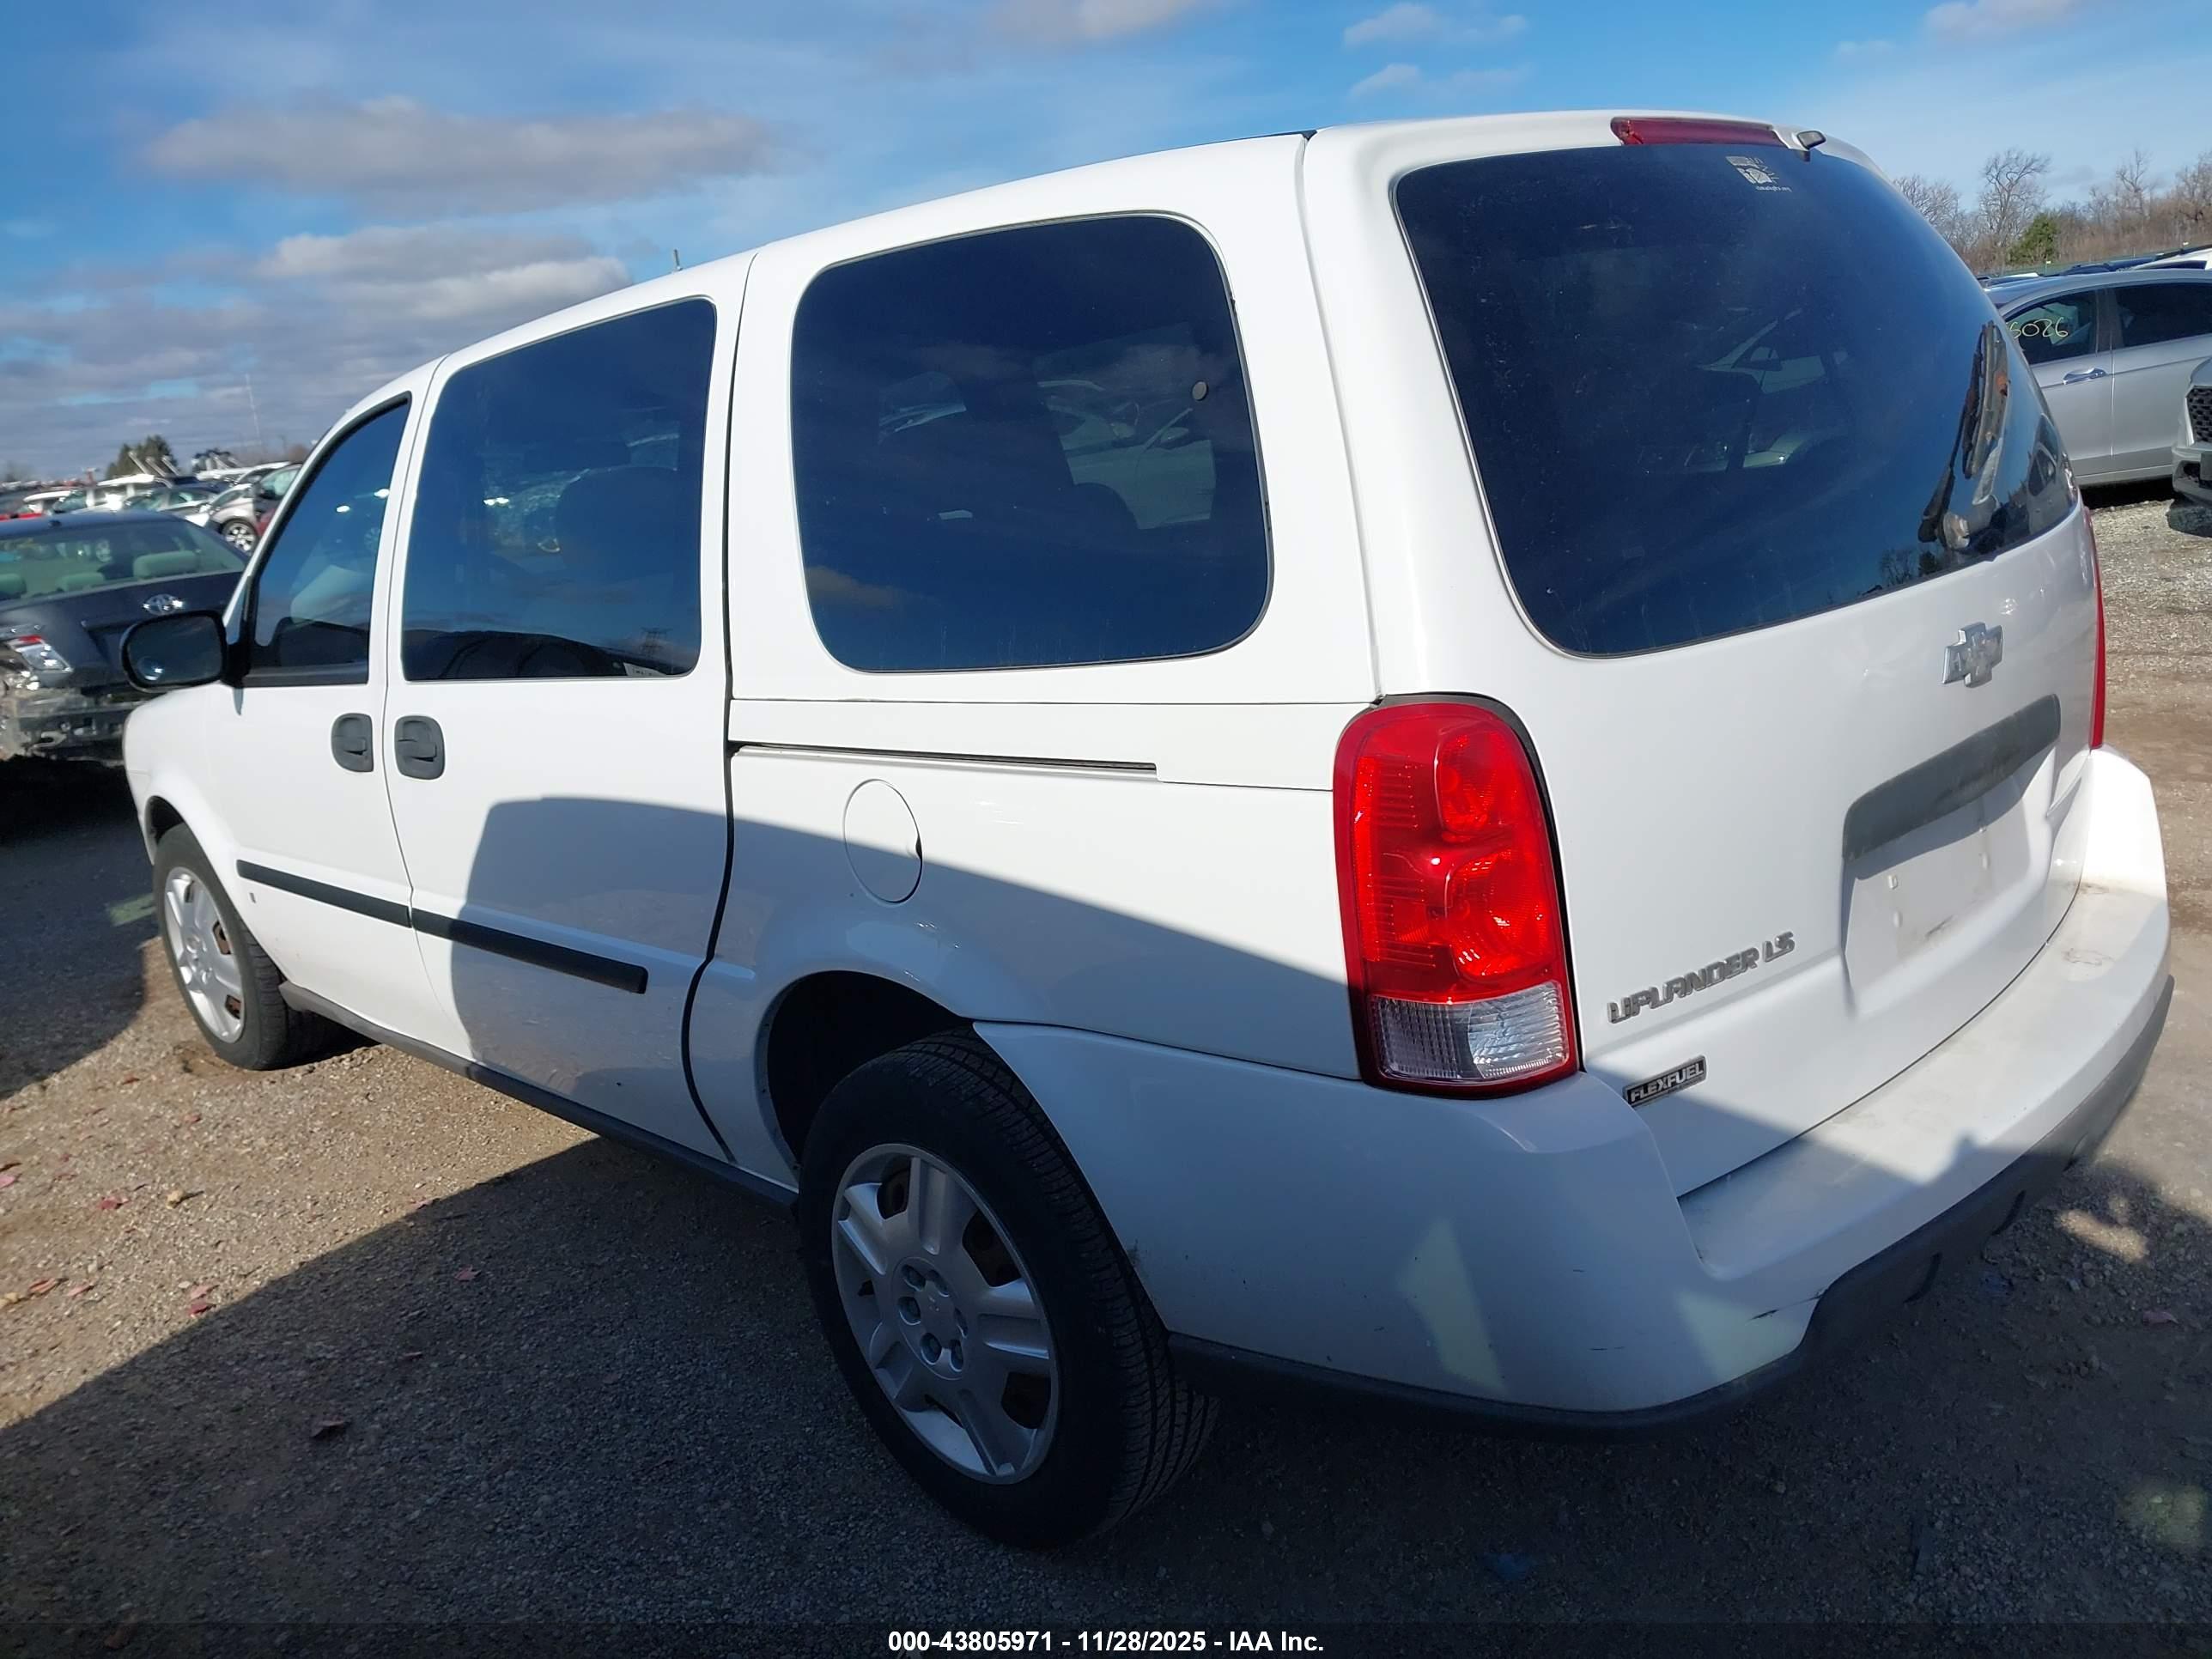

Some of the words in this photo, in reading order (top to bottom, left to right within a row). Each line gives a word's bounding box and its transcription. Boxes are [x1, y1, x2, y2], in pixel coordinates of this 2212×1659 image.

[1607, 947, 1760, 1024] UPLANDER
[1762, 931, 1796, 963] LS
[1631, 1061, 1705, 1103] FLEXFUEL
